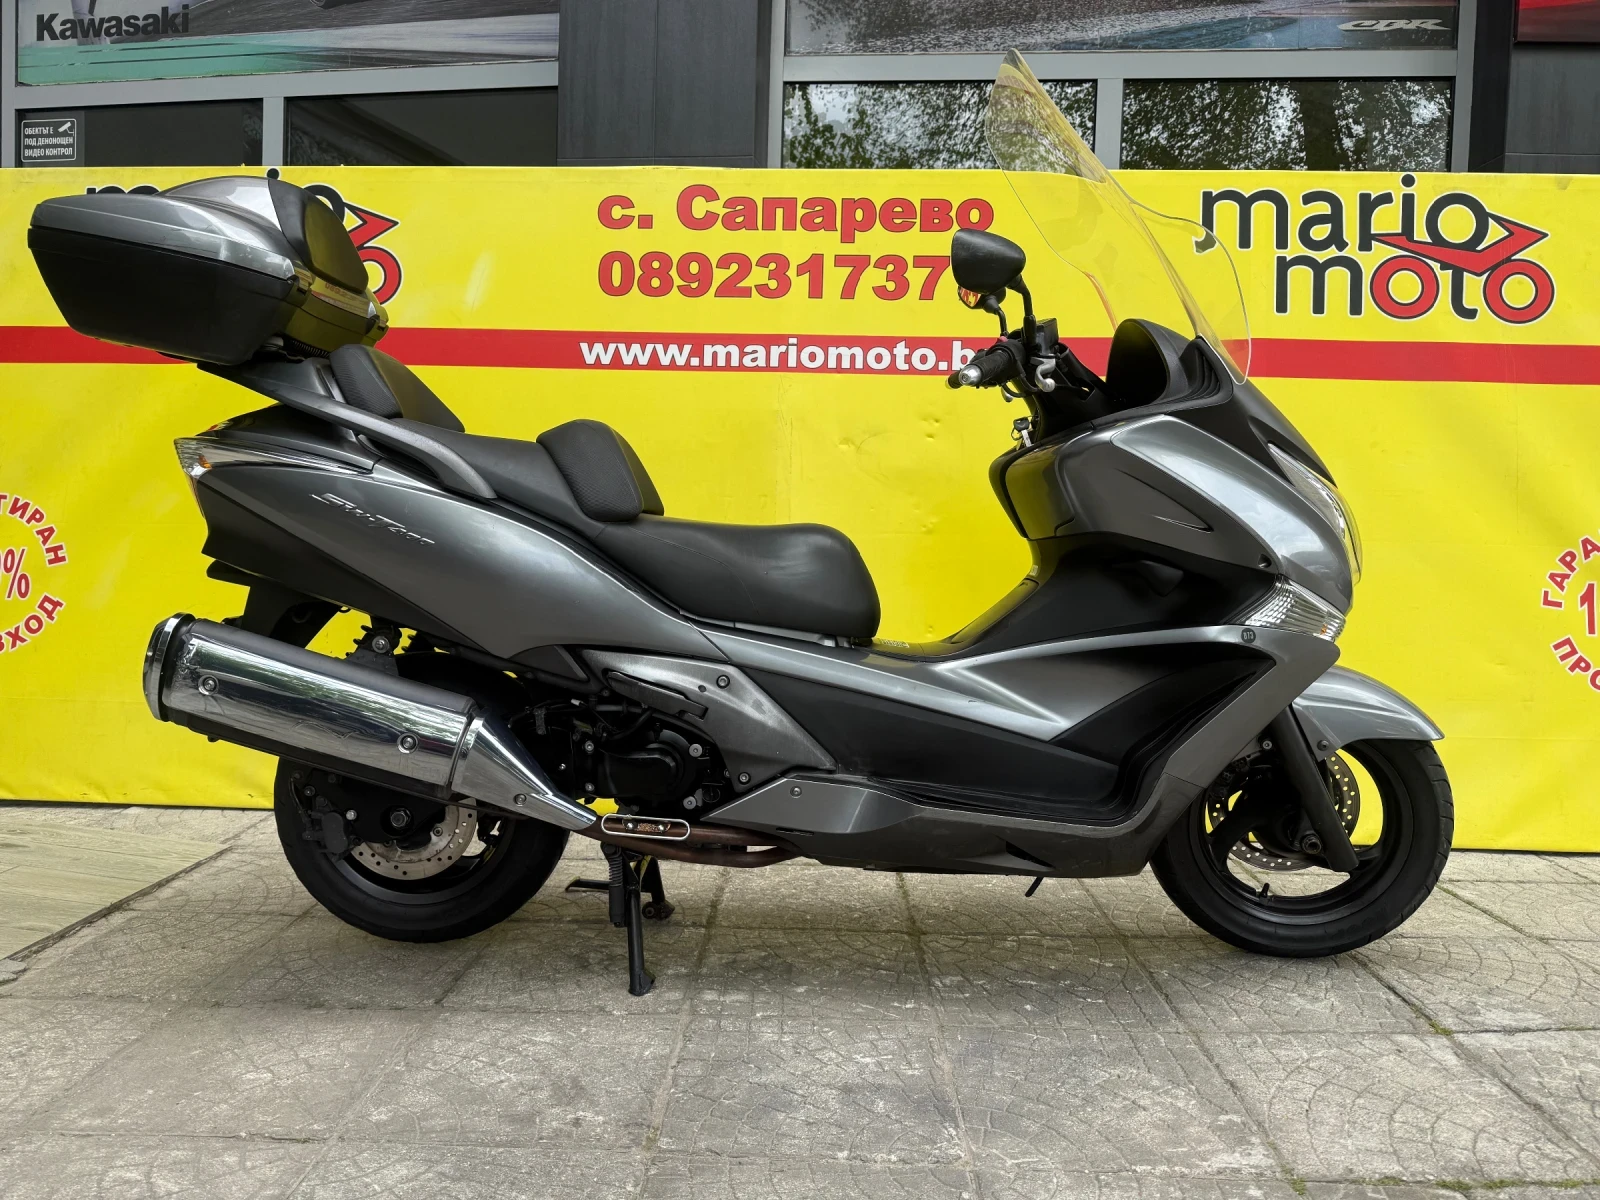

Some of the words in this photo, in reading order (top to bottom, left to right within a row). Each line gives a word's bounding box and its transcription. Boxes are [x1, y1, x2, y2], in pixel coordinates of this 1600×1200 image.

[36, 4, 190, 41] Kawasaki
[24, 127, 49, 135] ОБЕКТЪТ
[49, 126, 54, 134] Е
[24, 138, 37, 146] ПОД
[37, 137, 73, 146] ДЕНОНОЩЕН
[24, 148, 45, 158] ВИДЕО
[45, 147, 73, 156] КОНТРОЛ
[597, 195, 654, 230] с.
[676, 184, 995, 244] Сапарево
[1195, 173, 1490, 253] mario
[1275, 254, 1555, 324] moto
[579, 338, 986, 371] www.mariomoto.b
